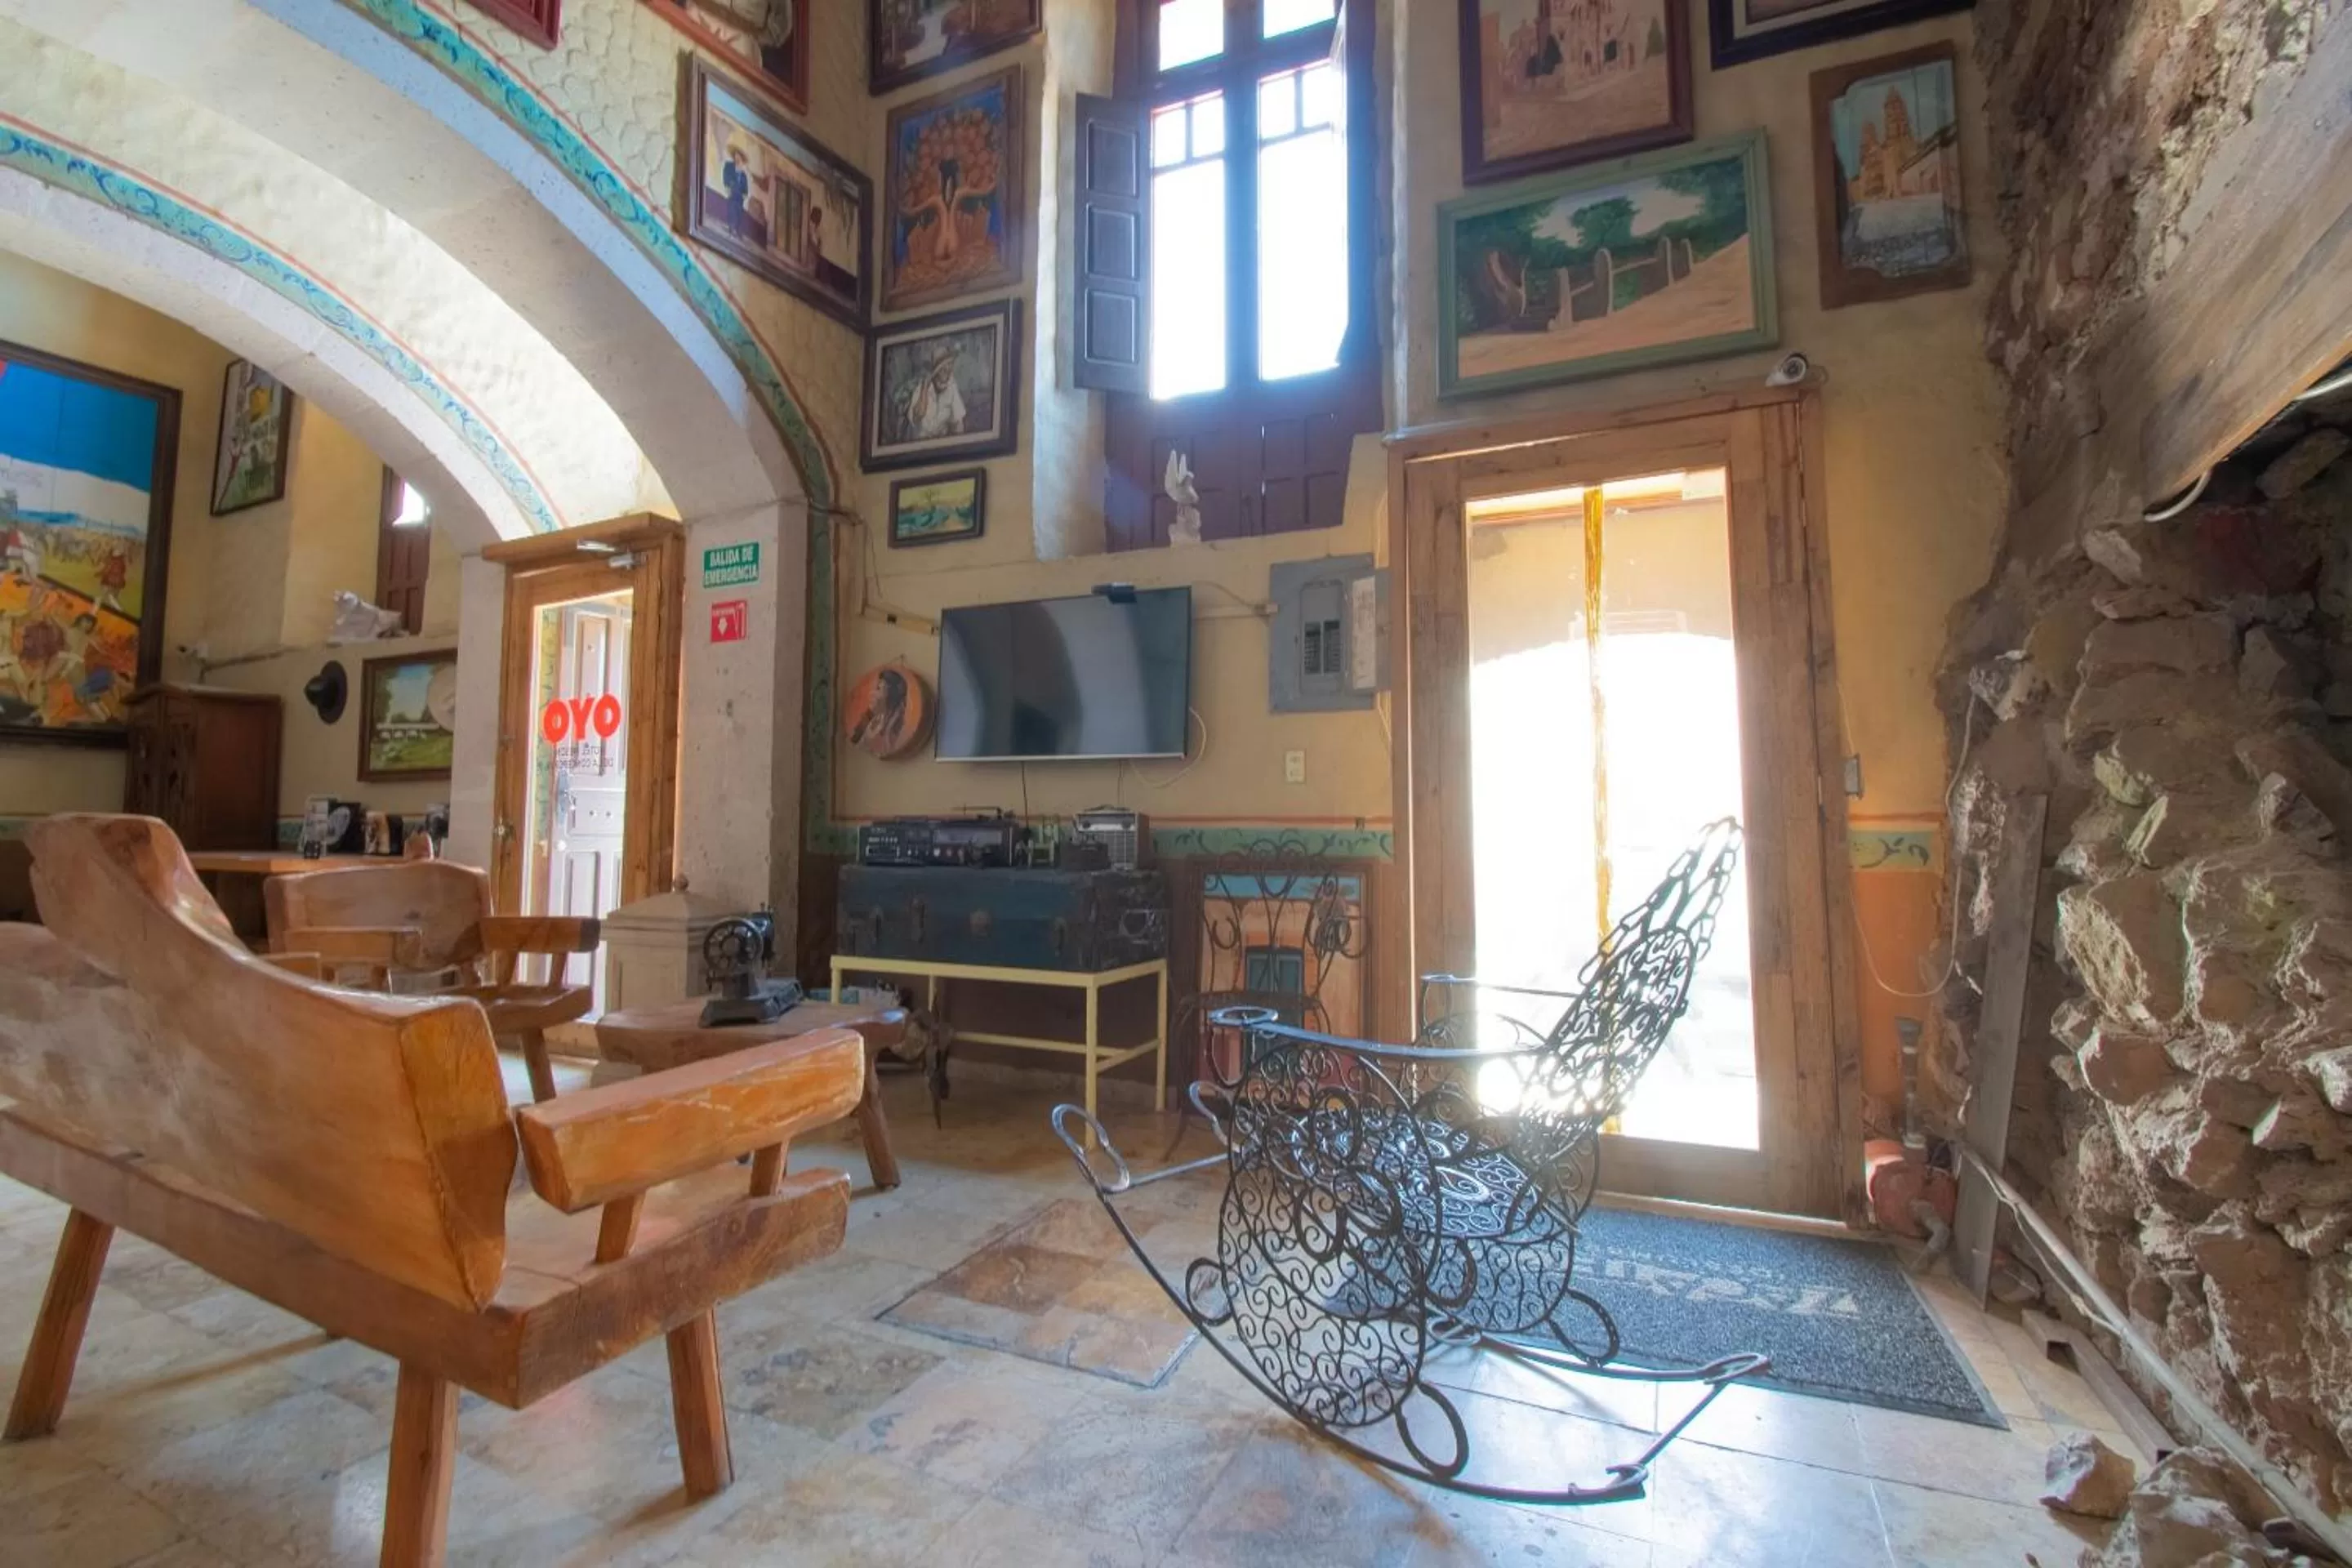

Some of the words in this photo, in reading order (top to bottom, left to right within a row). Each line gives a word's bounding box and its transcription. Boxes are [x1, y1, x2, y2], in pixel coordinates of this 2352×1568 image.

[709, 548, 739, 566] SALIDA
[742, 545, 754, 562] DE
[705, 564, 757, 585] EMERGENCIA
[543, 694, 621, 742] OYO
